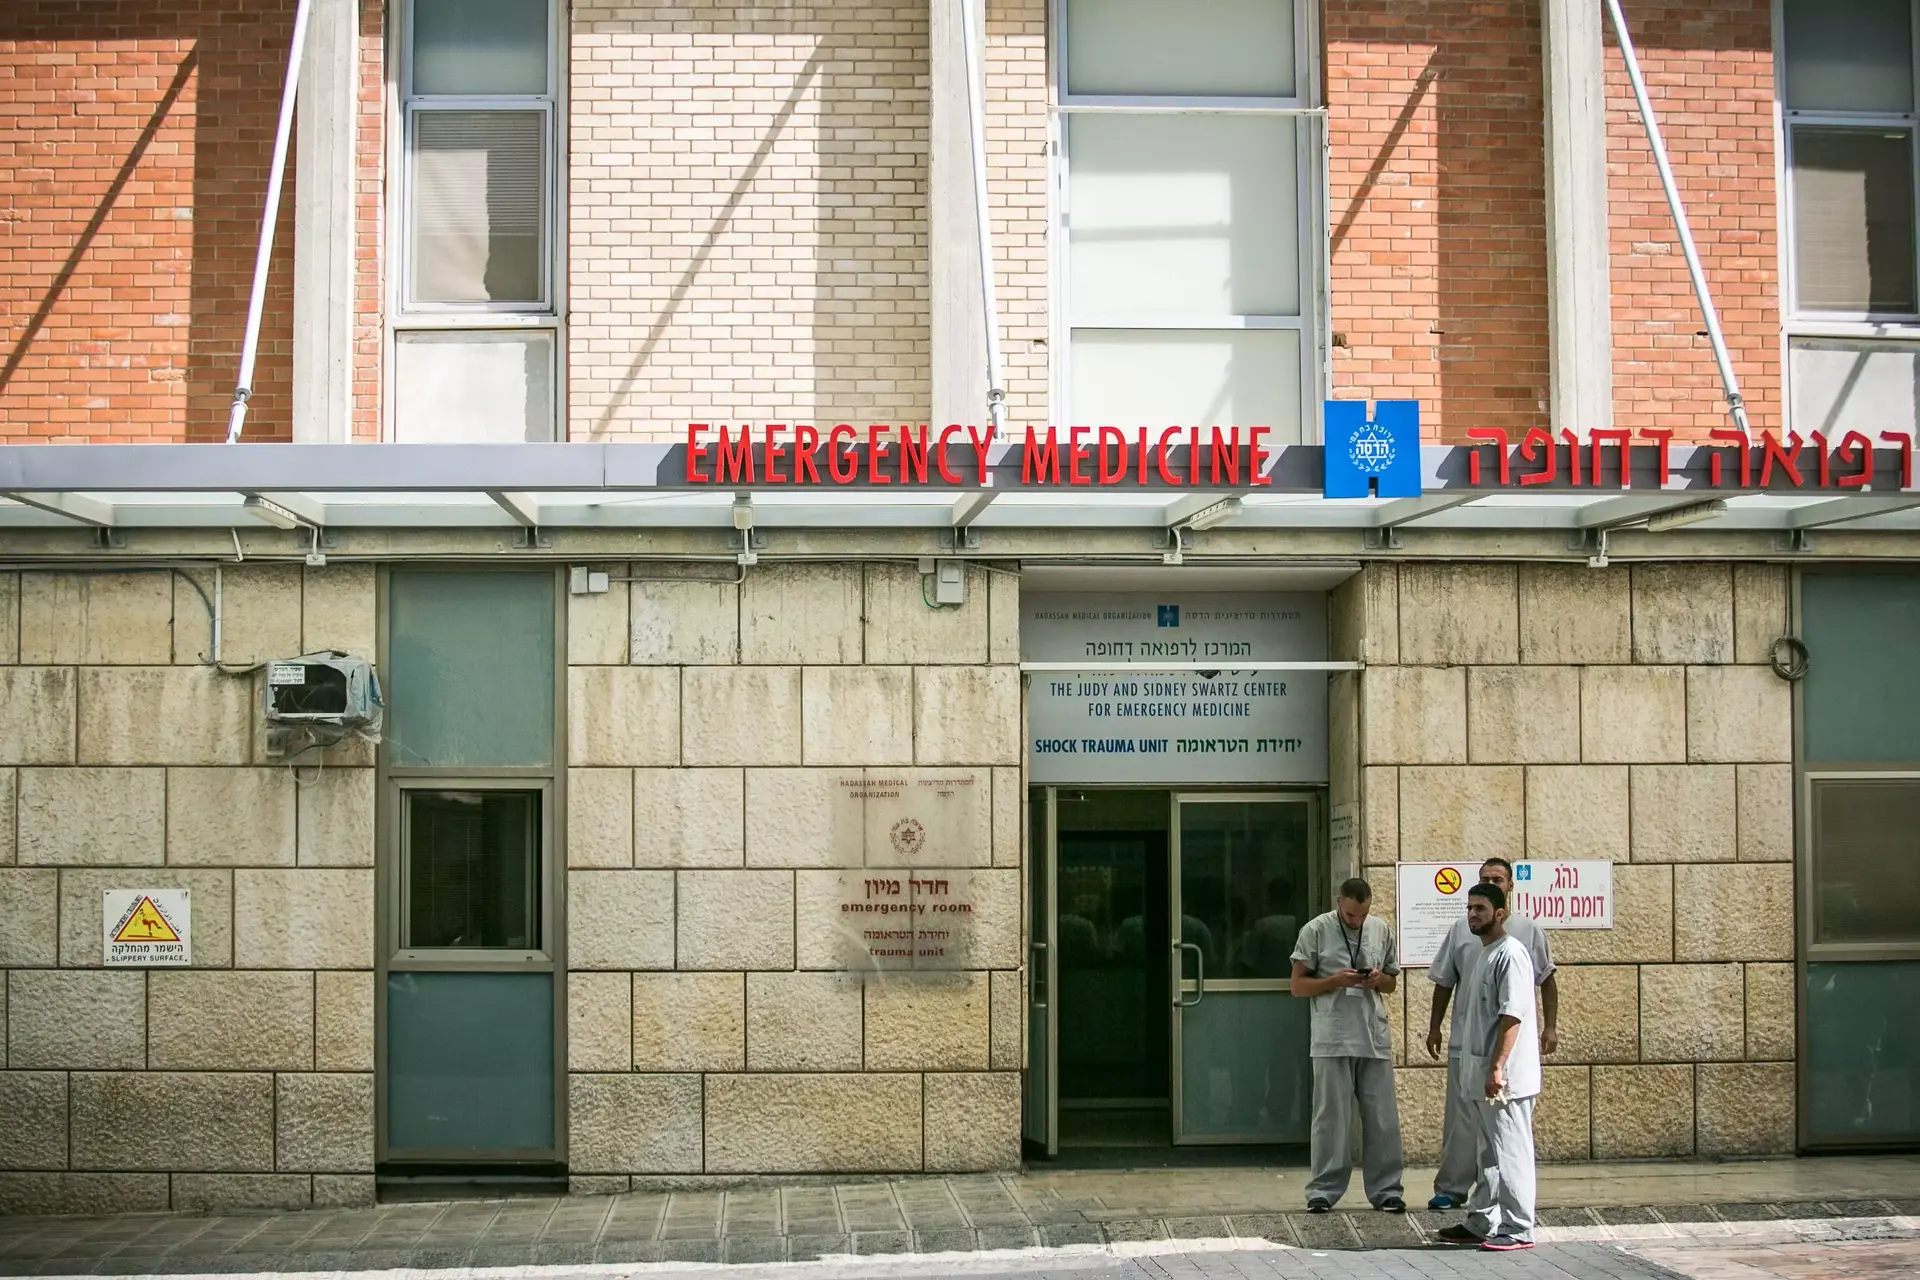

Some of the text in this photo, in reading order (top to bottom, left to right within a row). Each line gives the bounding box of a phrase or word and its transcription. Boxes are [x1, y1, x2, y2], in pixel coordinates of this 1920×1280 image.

[686, 423, 1273, 486] EMERGENCY MEDICINE
[1355, 443, 1389, 455] הדסה
[1466, 427, 1912, 488] רפואה דחופה
[1034, 612, 1152, 620] HADASSAH MEDICAL ORGANIZATION
[1185, 611, 1210, 620] הדסה
[1086, 637, 1251, 656] המרכז לרפואה דחופה
[1050, 683, 1287, 696] THE JUDY AND SIDNEY SWARTZ CENTER
[1088, 703, 1250, 717] FOR EMERGENCY MEDICINE
[1035, 739, 1168, 753] SHOCK TRAUMA UNIT
[1176, 739, 1302, 753] יחידת הטראומה
[864, 879, 949, 899] חדר מיון
[841, 902, 972, 915] emergency room
[1570, 895, 1605, 918] דומם
[863, 930, 949, 940] יחידת הטראומה
[111, 943, 184, 954] הישמר מהחלקה
[869, 947, 945, 957] trauma unit
